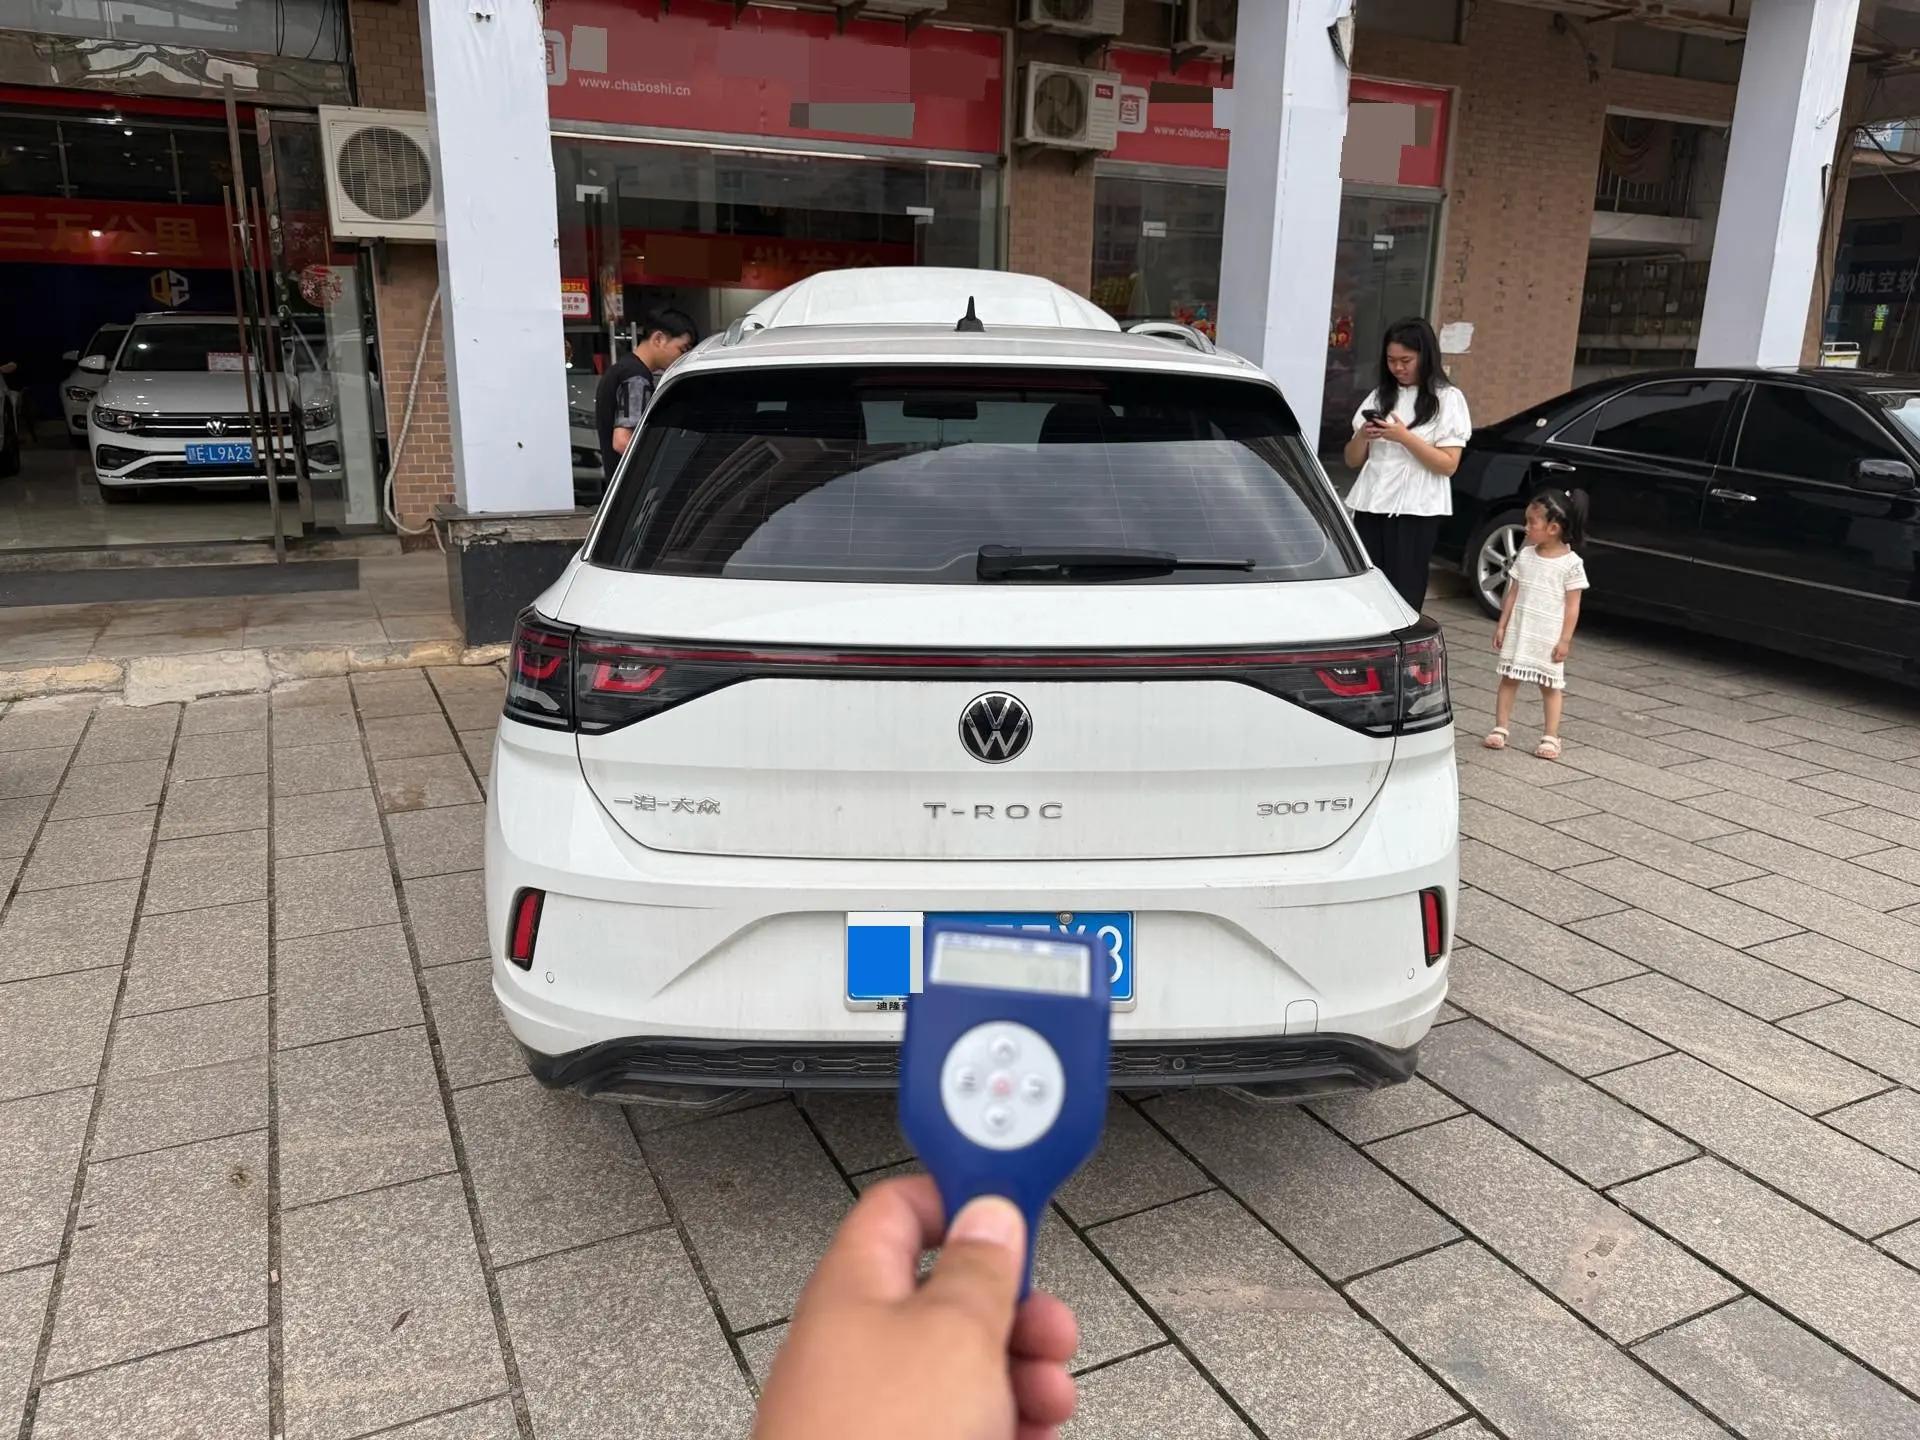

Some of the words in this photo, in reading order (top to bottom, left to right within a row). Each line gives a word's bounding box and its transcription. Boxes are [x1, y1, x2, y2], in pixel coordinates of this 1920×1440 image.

[578, 76, 691, 96] www.chaboshi.cn
[923, 802, 1062, 819] T-ROC
[1256, 802, 1308, 816] 300
[1314, 797, 1353, 812] TSI
